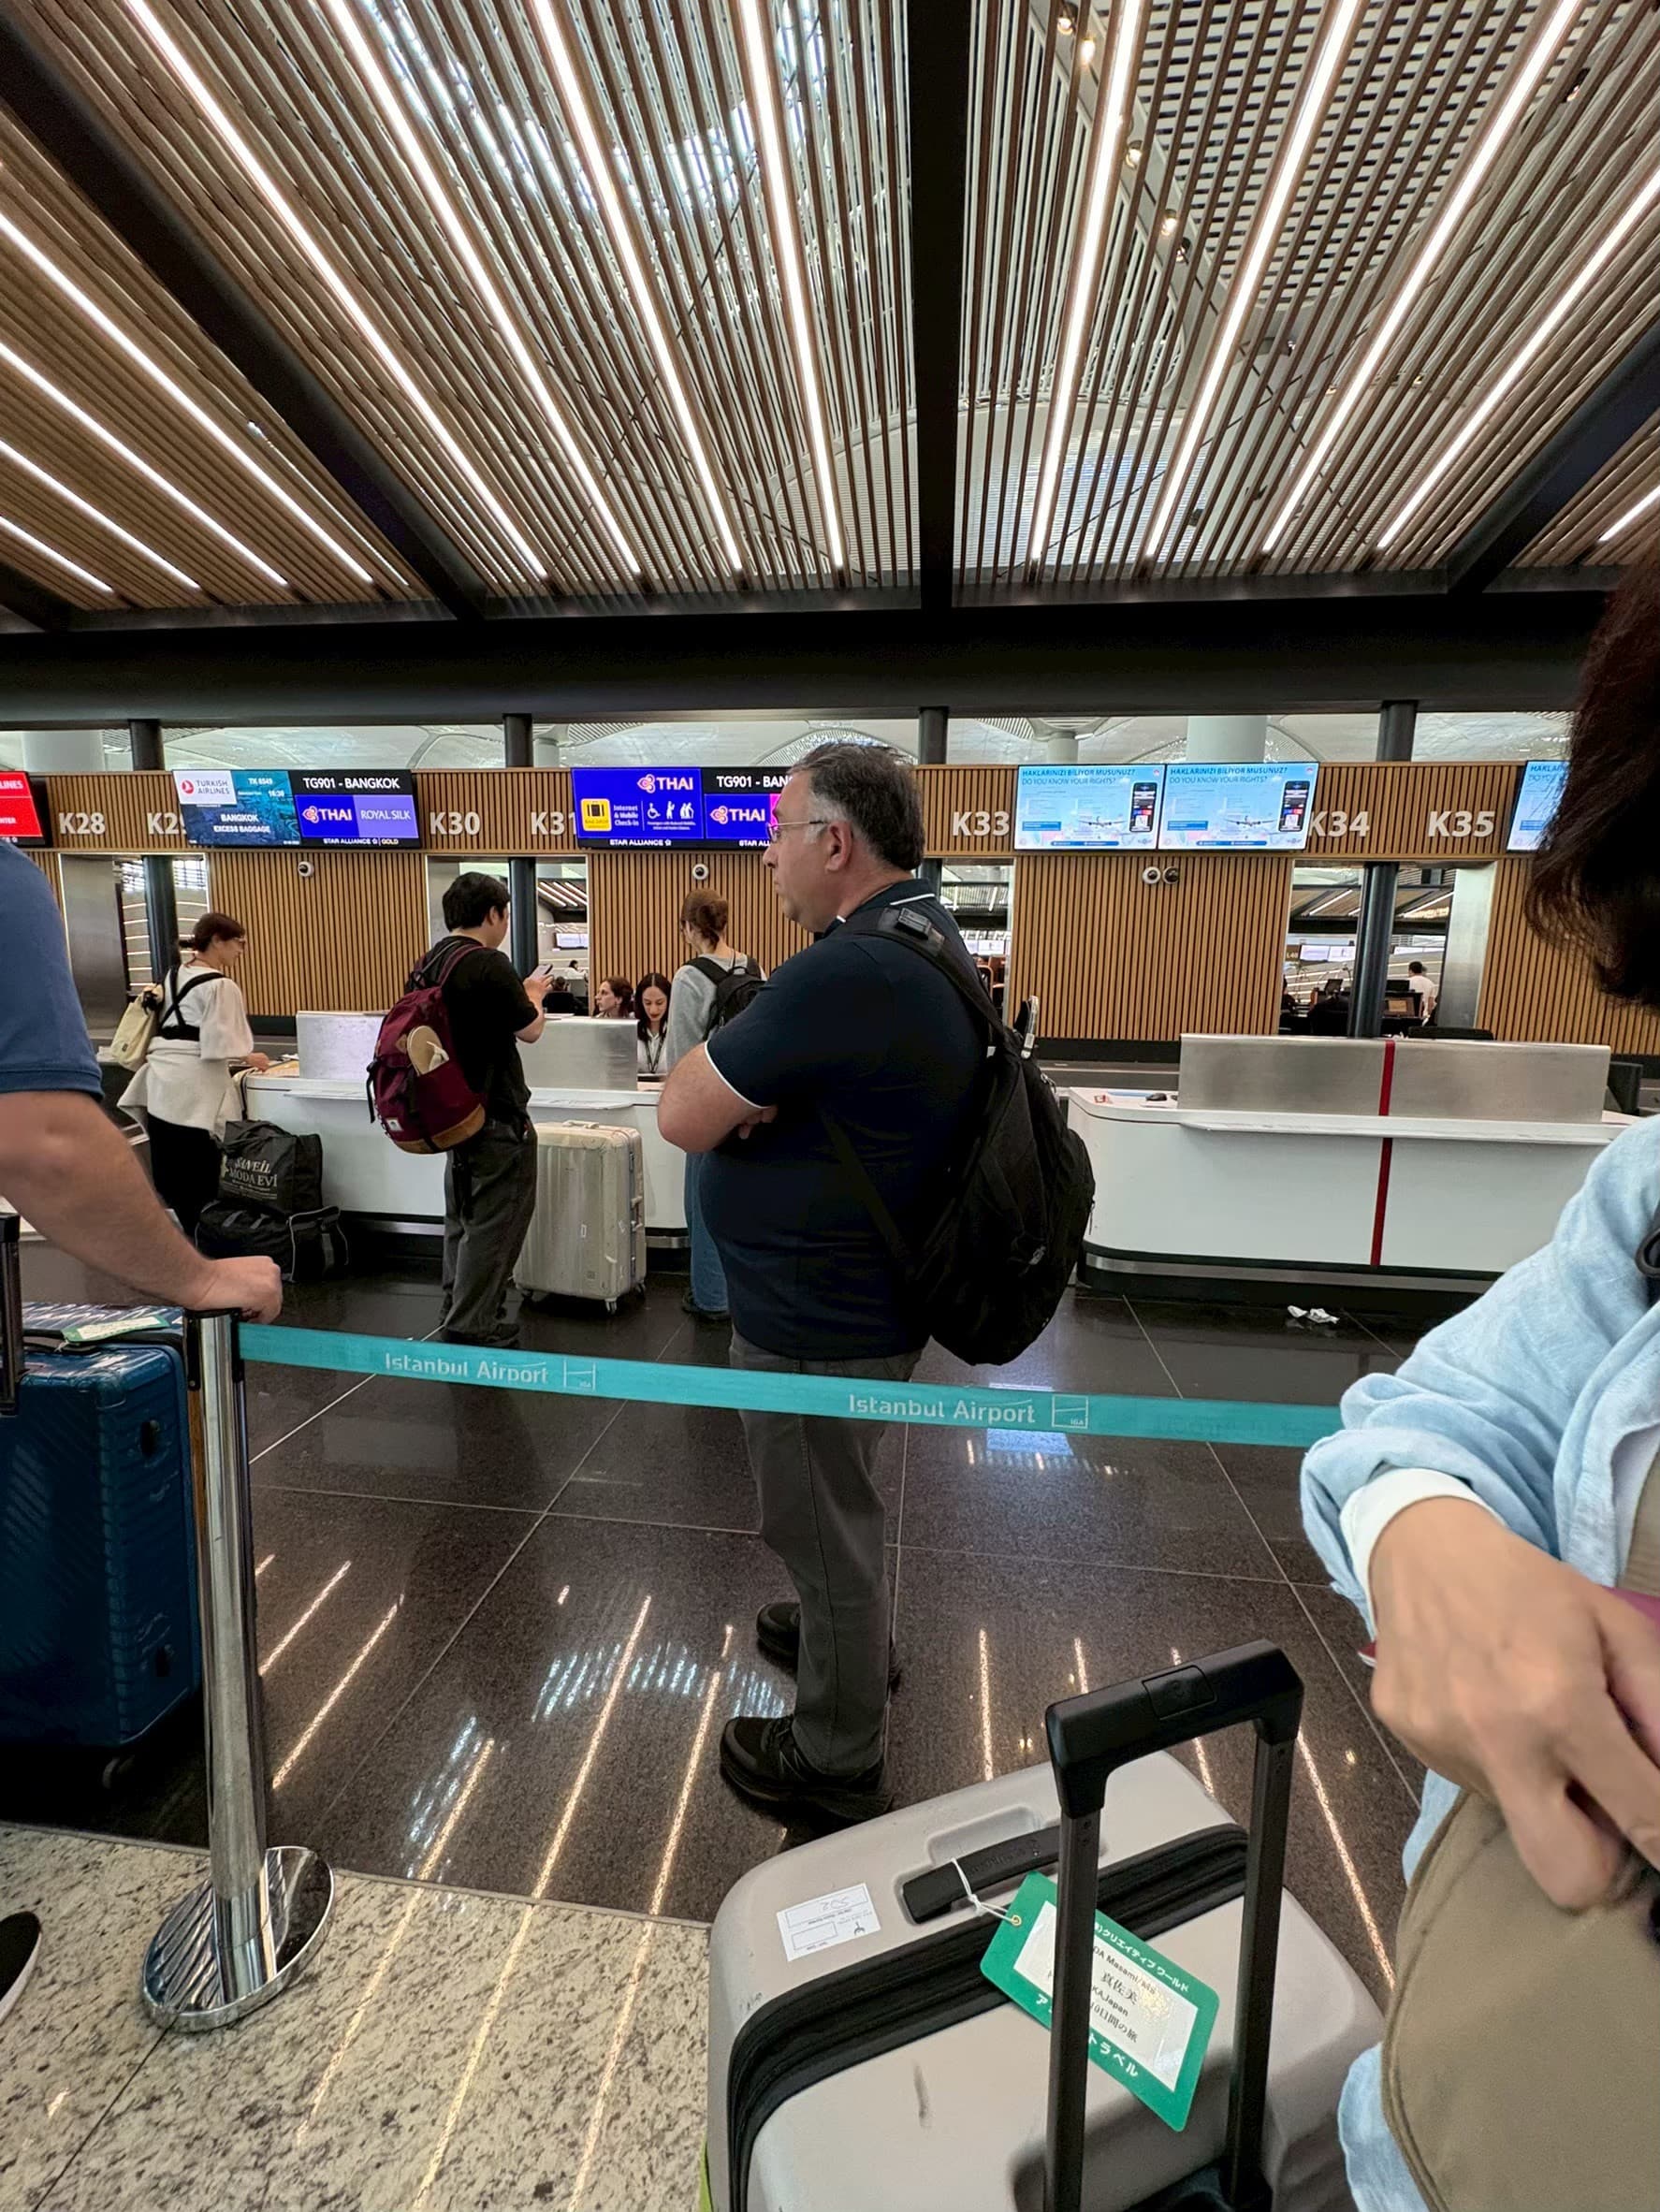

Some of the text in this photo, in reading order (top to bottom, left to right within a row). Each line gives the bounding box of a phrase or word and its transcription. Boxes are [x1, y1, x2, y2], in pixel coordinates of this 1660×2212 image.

[303, 778, 336, 789] TG901
[344, 778, 400, 789] BANGKOK
[657, 778, 693, 791] THAI
[716, 776, 752, 788] TG901
[58, 812, 106, 835] K28
[319, 808, 353, 821] THAI
[360, 810, 412, 821] ROYAL SILK
[430, 811, 481, 836] K30
[728, 808, 766, 822] THAI
[952, 810, 1011, 837] K33
[1308, 811, 1370, 837] K34
[1427, 810, 1495, 837] K35
[240, 825, 270, 834] BAGGAGE
[386, 1353, 548, 1384] Istanbul Airport
[849, 1394, 1036, 1425] Istanbul Airport
[1100, 1972, 1139, 2005] 真佐美
[1157, 1966, 1189, 1993] ワールド
